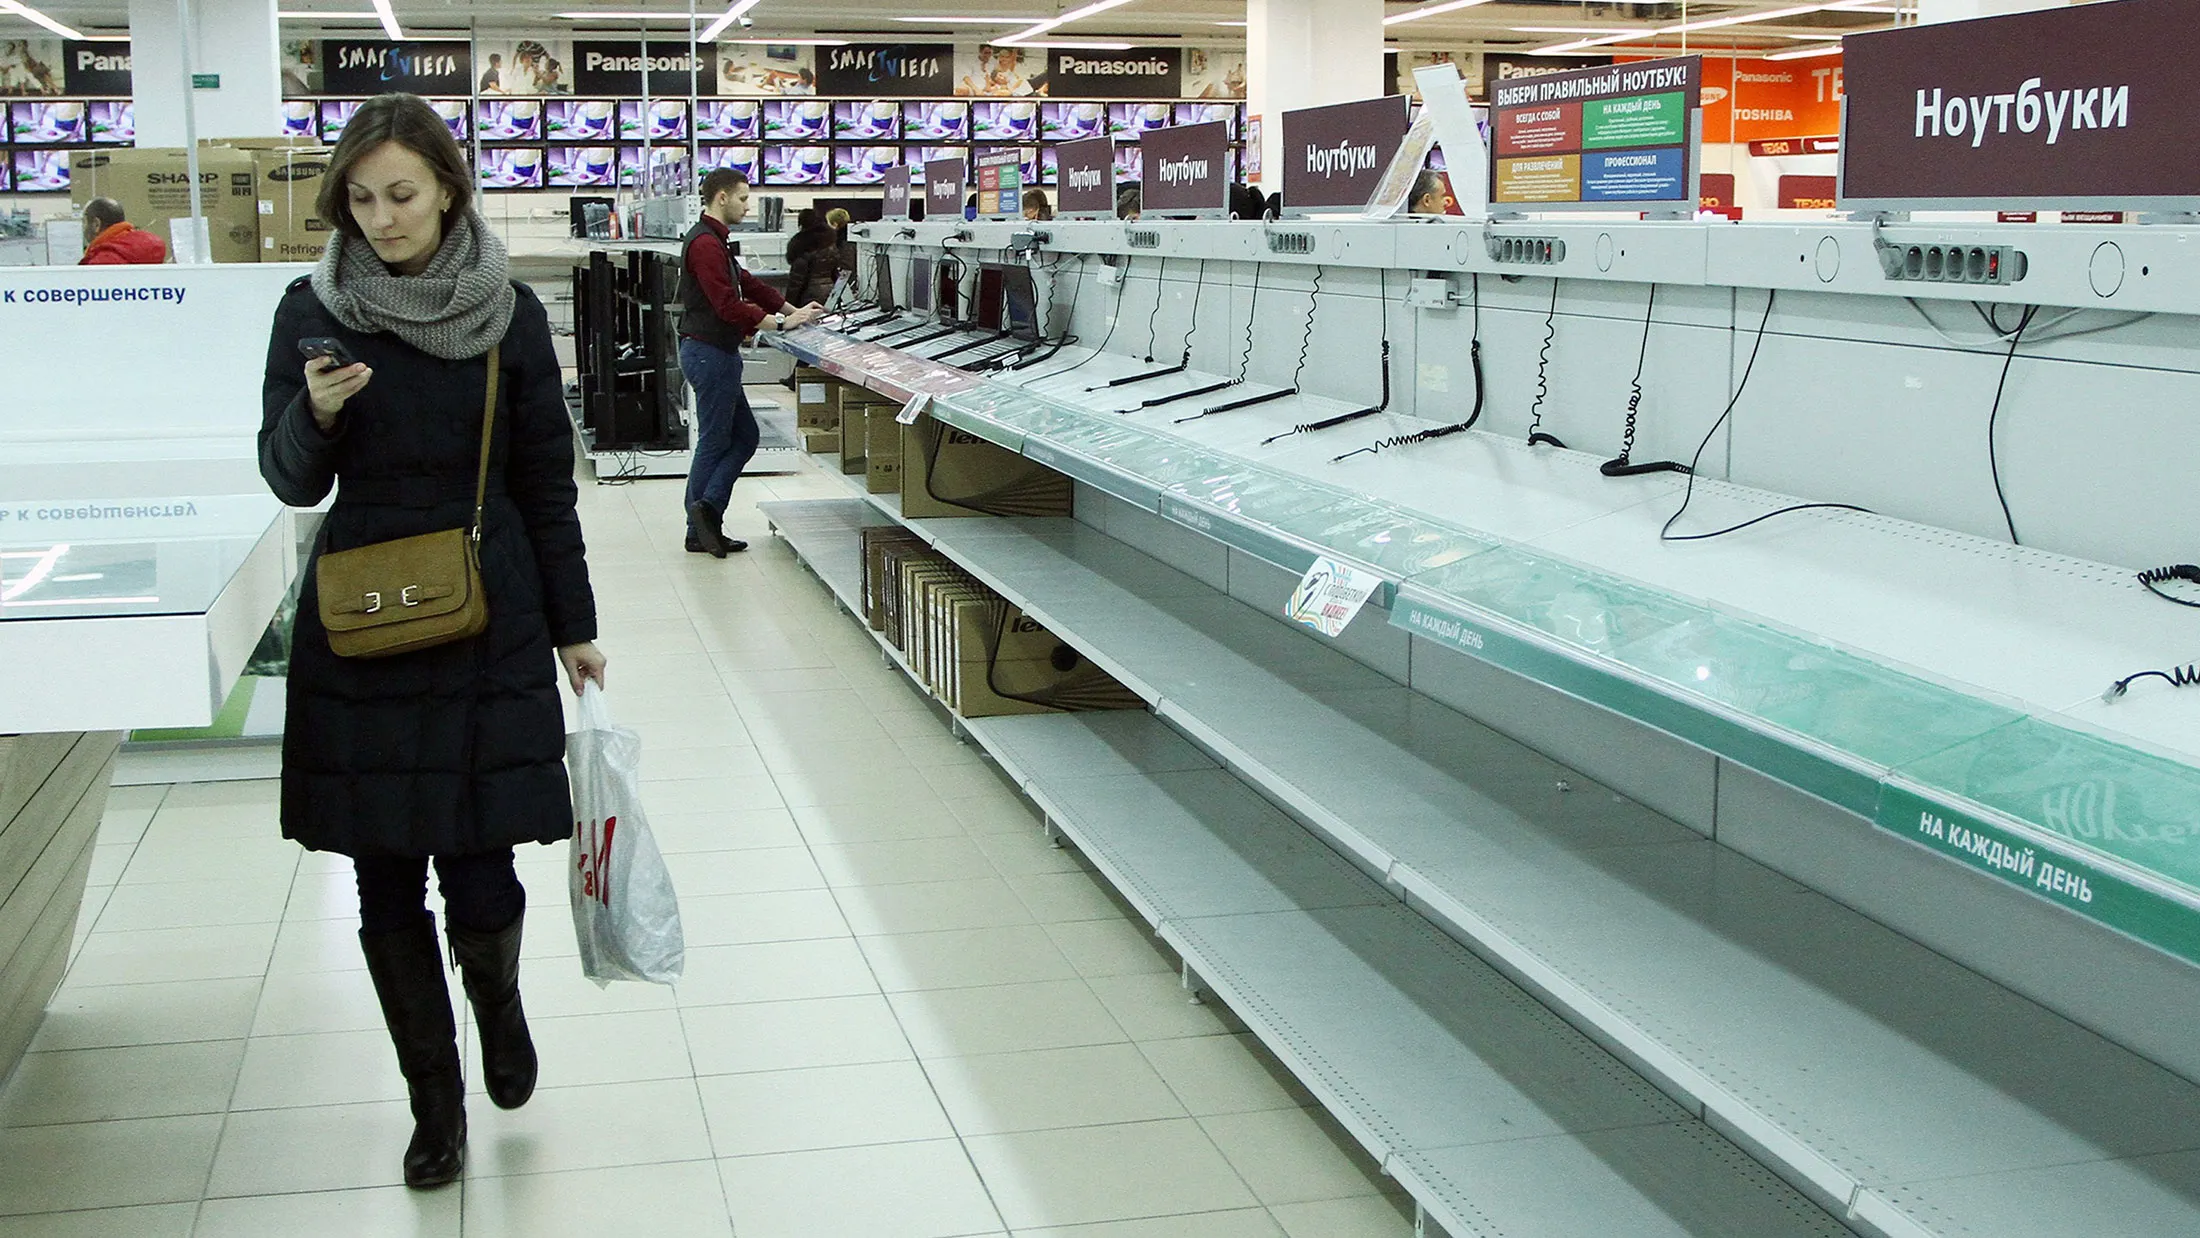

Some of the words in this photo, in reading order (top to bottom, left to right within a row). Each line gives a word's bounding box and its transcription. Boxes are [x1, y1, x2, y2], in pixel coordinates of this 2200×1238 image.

[586, 52, 704, 72] Panasonic
[1058, 55, 1169, 76] Panasonic
[1497, 85, 1538, 107] ВЫБЕРИ
[1540, 69, 1620, 102] ПРАВИЛЬНЫЙ
[1622, 65, 1688, 93] НОУТБУК!
[1735, 71, 1793, 83] Panasonic
[1603, 104, 1613, 114] НА
[1612, 98, 1642, 114] КАЖДЫЙ
[1642, 100, 1662, 112] ДЕНЬ
[1734, 109, 1793, 121] TOSHIBA
[1915, 78, 2129, 148] Ноутбуки
[1159, 155, 1208, 187] Ноутбуки
[1306, 140, 1377, 178] Ноутбуки
[148, 173, 218, 184] SHAP
[1068, 165, 1102, 192] Ноутбуки
[4, 291, 15, 303] к
[24, 287, 186, 305] совершенству
[1409, 610, 1421, 624] НА
[1421, 614, 1461, 640] КАЖДЫЙ
[1459, 628, 1484, 649] ДЕНЬ
[1919, 811, 1944, 840] НА
[1947, 823, 2036, 878] КАЖДЫЙ
[2036, 862, 2093, 903] ДЕНЬ
